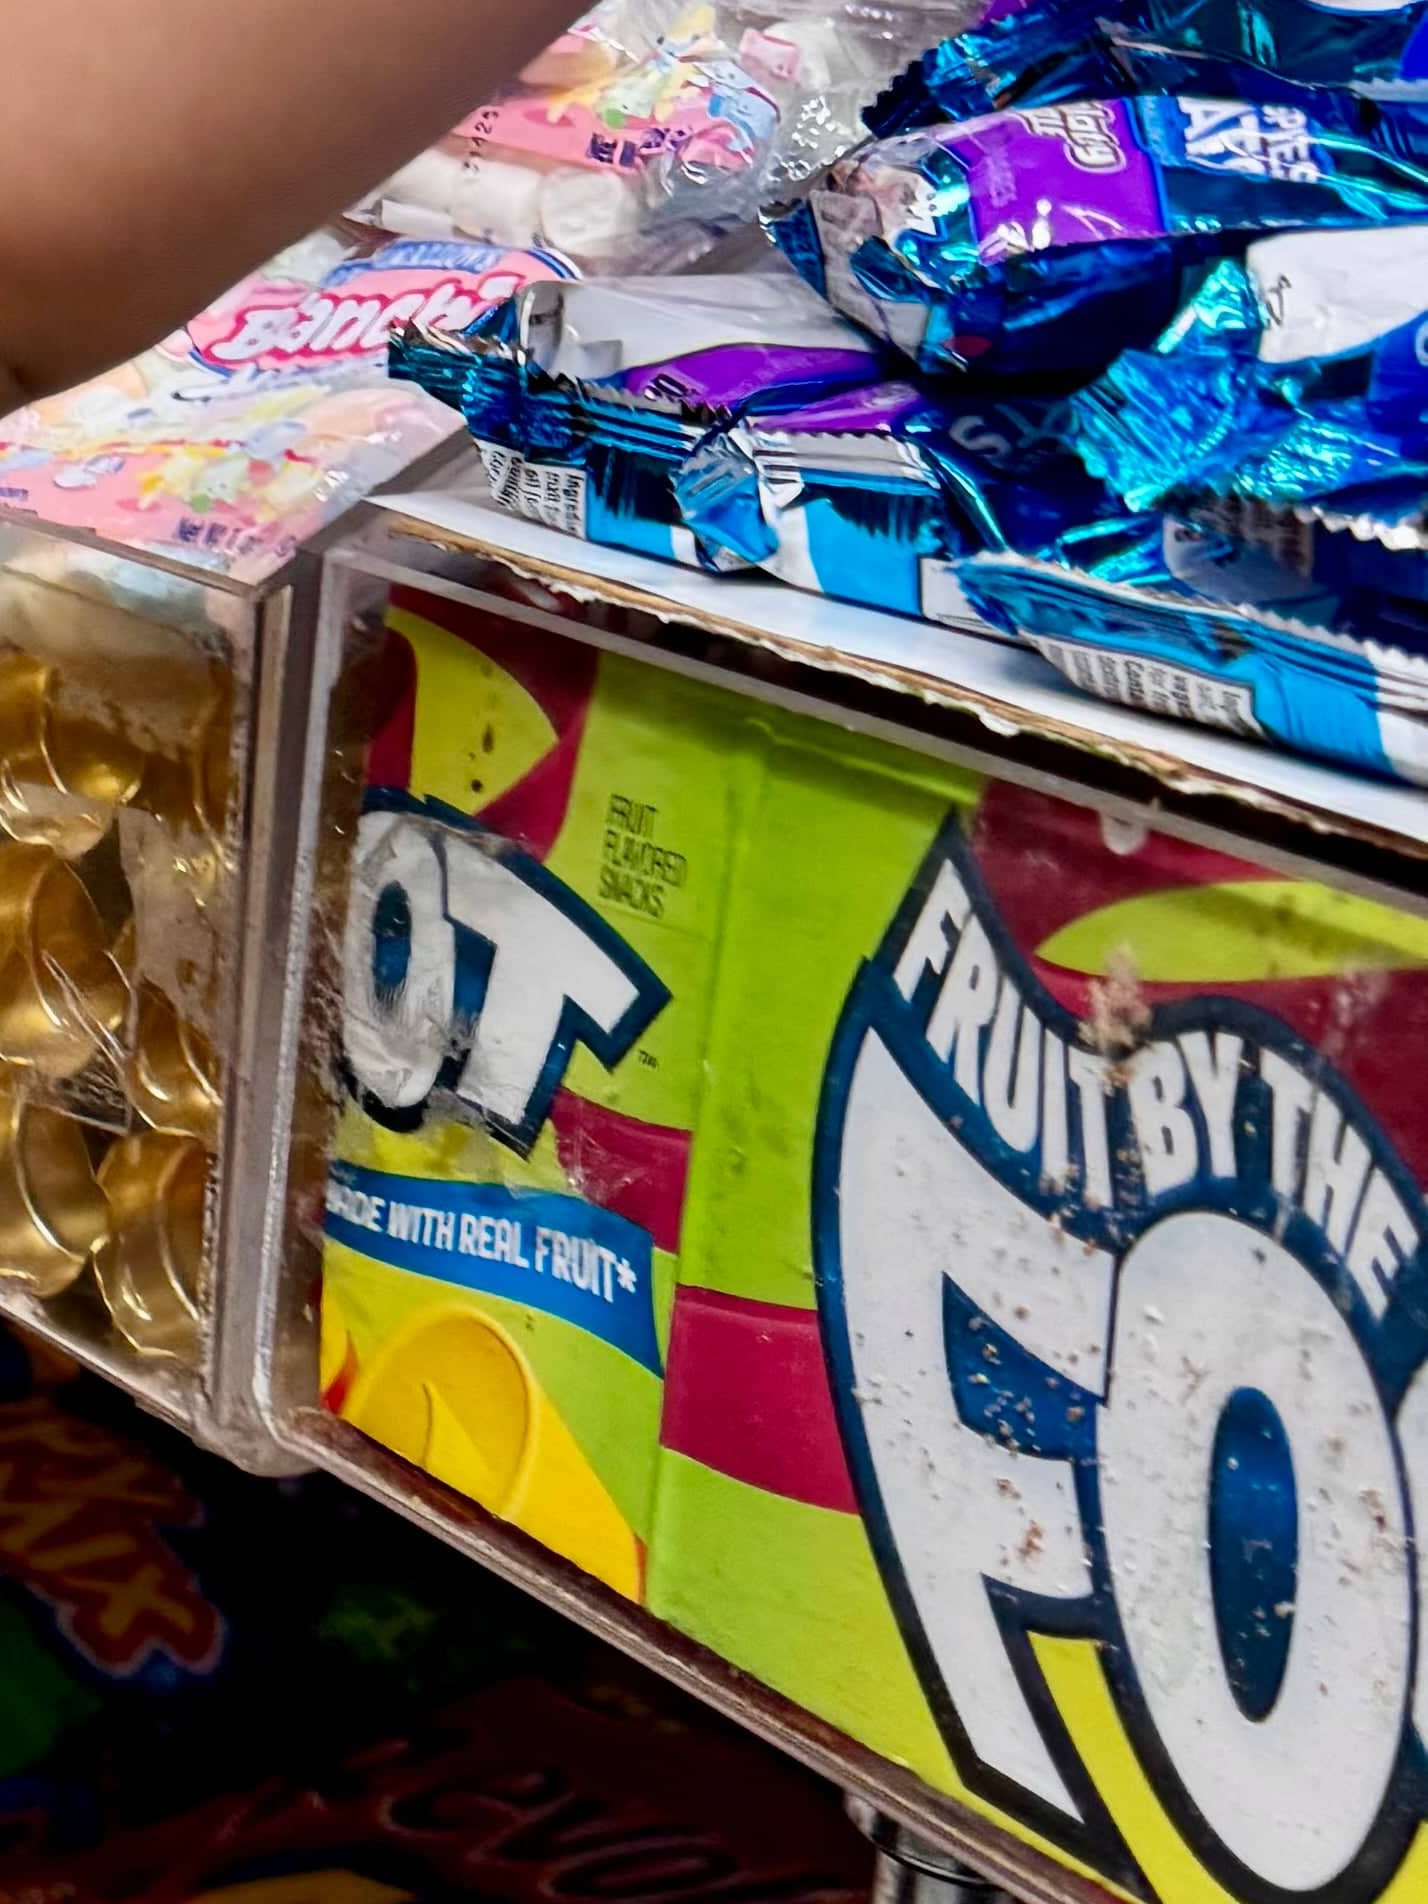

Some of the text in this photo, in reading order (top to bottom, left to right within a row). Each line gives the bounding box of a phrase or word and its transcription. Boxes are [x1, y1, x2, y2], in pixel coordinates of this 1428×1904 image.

[608, 792, 658, 839] FRUIT
[598, 867, 666, 920] SNACKS
[602, 829, 688, 891] FLAVORED
[340, 809, 640, 1127] OT
[890, 856, 1421, 1326] FRUIT BY THE
[385, 1203, 456, 1252] WITH
[458, 1211, 530, 1270] REAL
[834, 1018, 1428, 1898] FO
